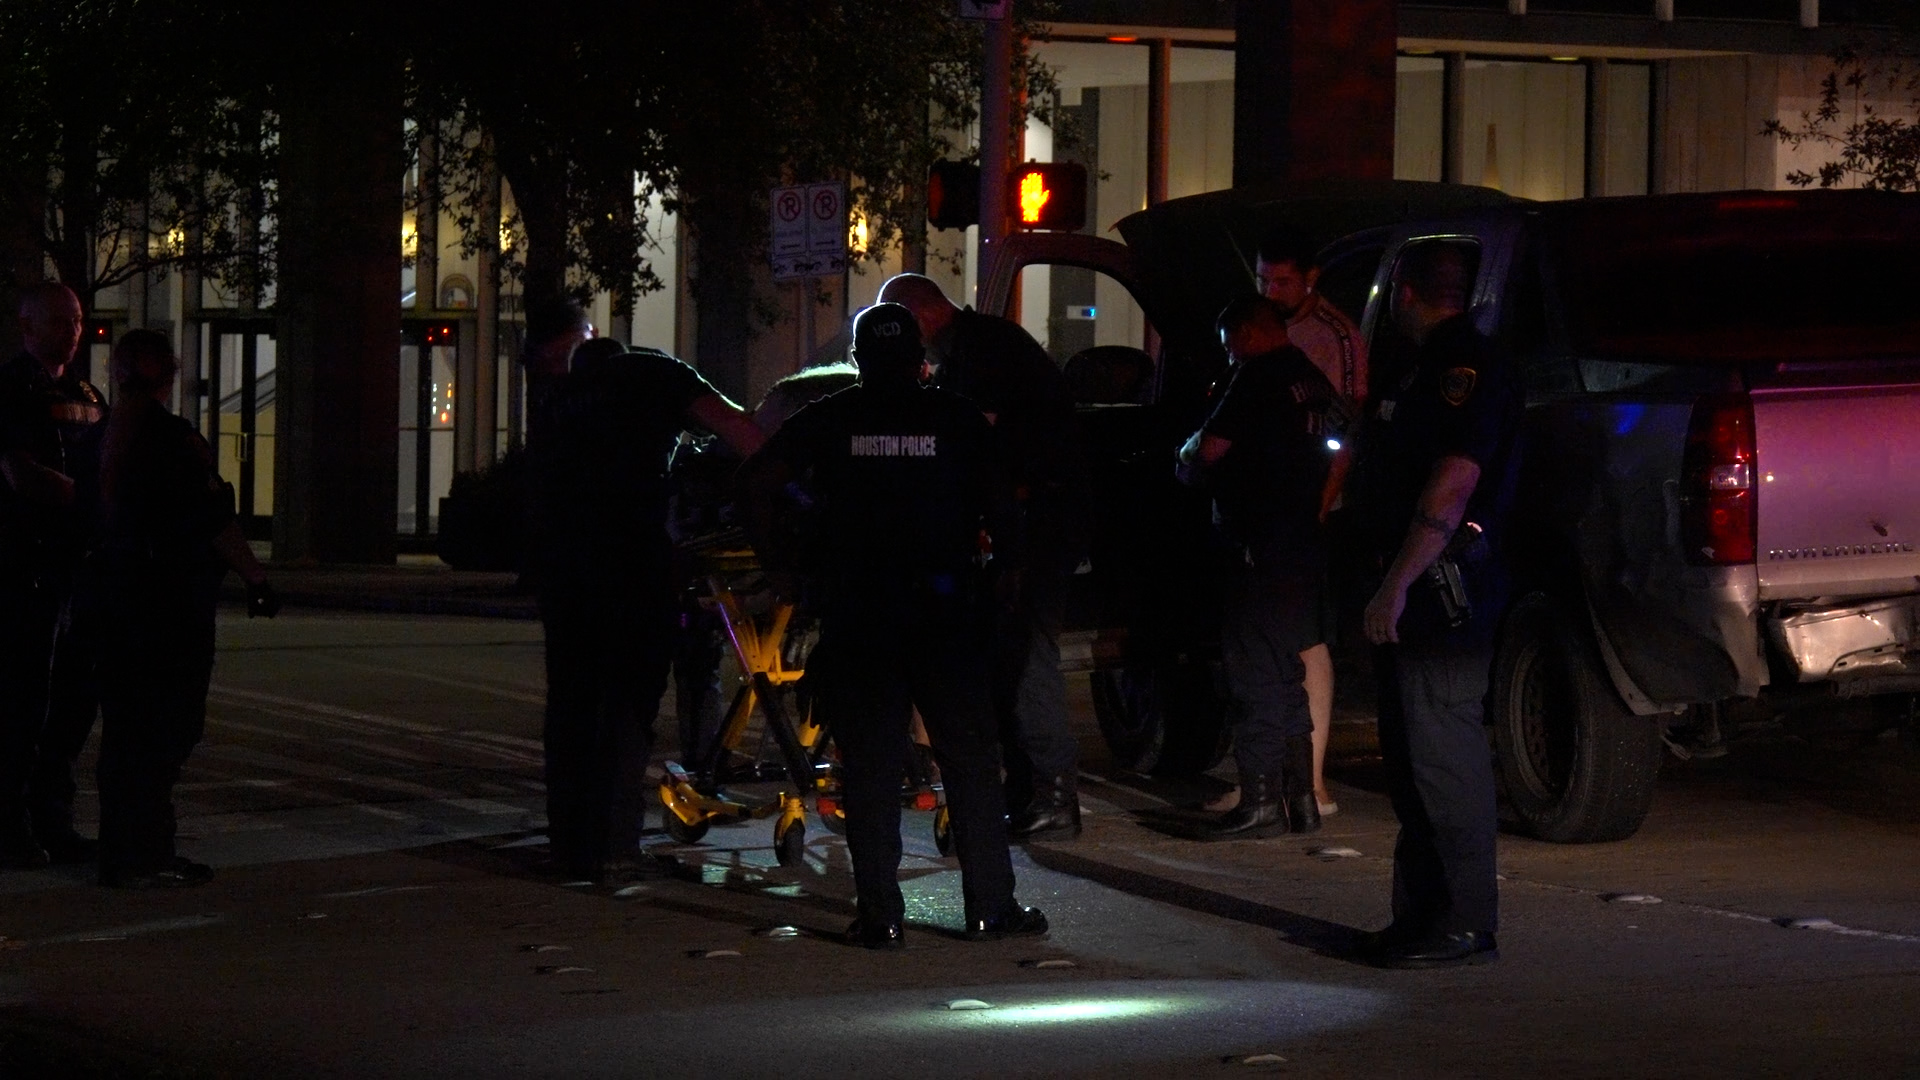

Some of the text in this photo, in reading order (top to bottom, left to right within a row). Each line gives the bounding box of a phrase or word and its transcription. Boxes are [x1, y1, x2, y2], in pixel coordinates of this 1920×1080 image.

[851, 435, 937, 457] HOUSTON POLICE
[1770, 543, 1913, 560] AVALANCHE
